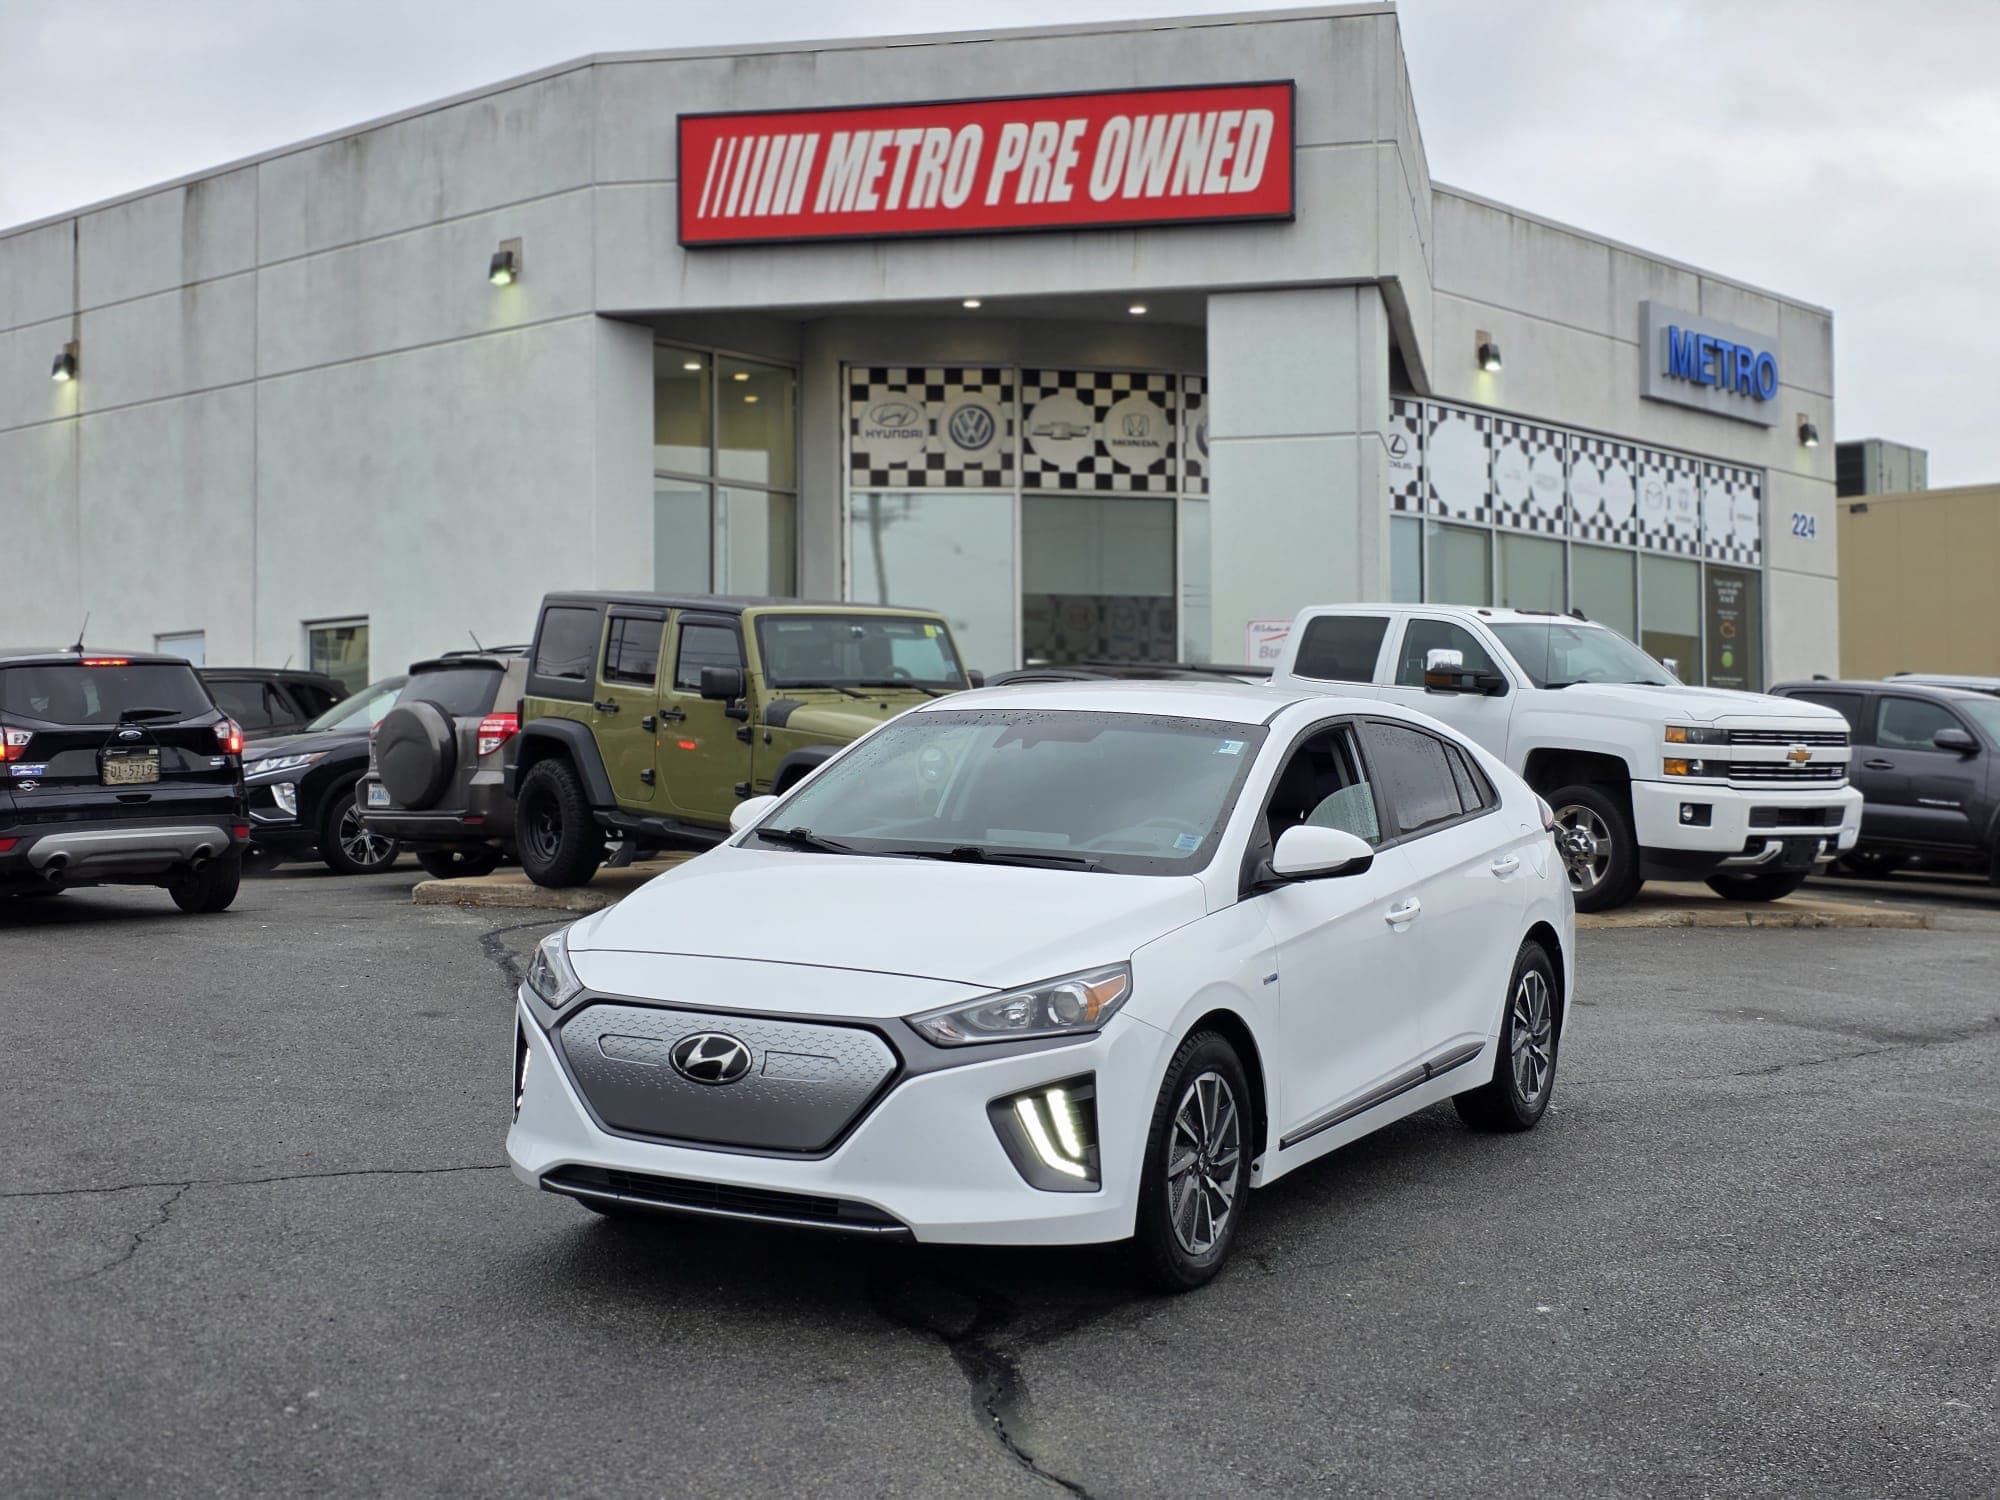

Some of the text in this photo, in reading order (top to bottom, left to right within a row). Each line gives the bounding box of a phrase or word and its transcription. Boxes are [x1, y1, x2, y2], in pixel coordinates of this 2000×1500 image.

[814, 107, 1276, 214] METRO PRE OWNED
[1668, 325, 1778, 401] METRO
[1111, 438, 1161, 450] HONDA
[1792, 512, 1817, 539] 224
